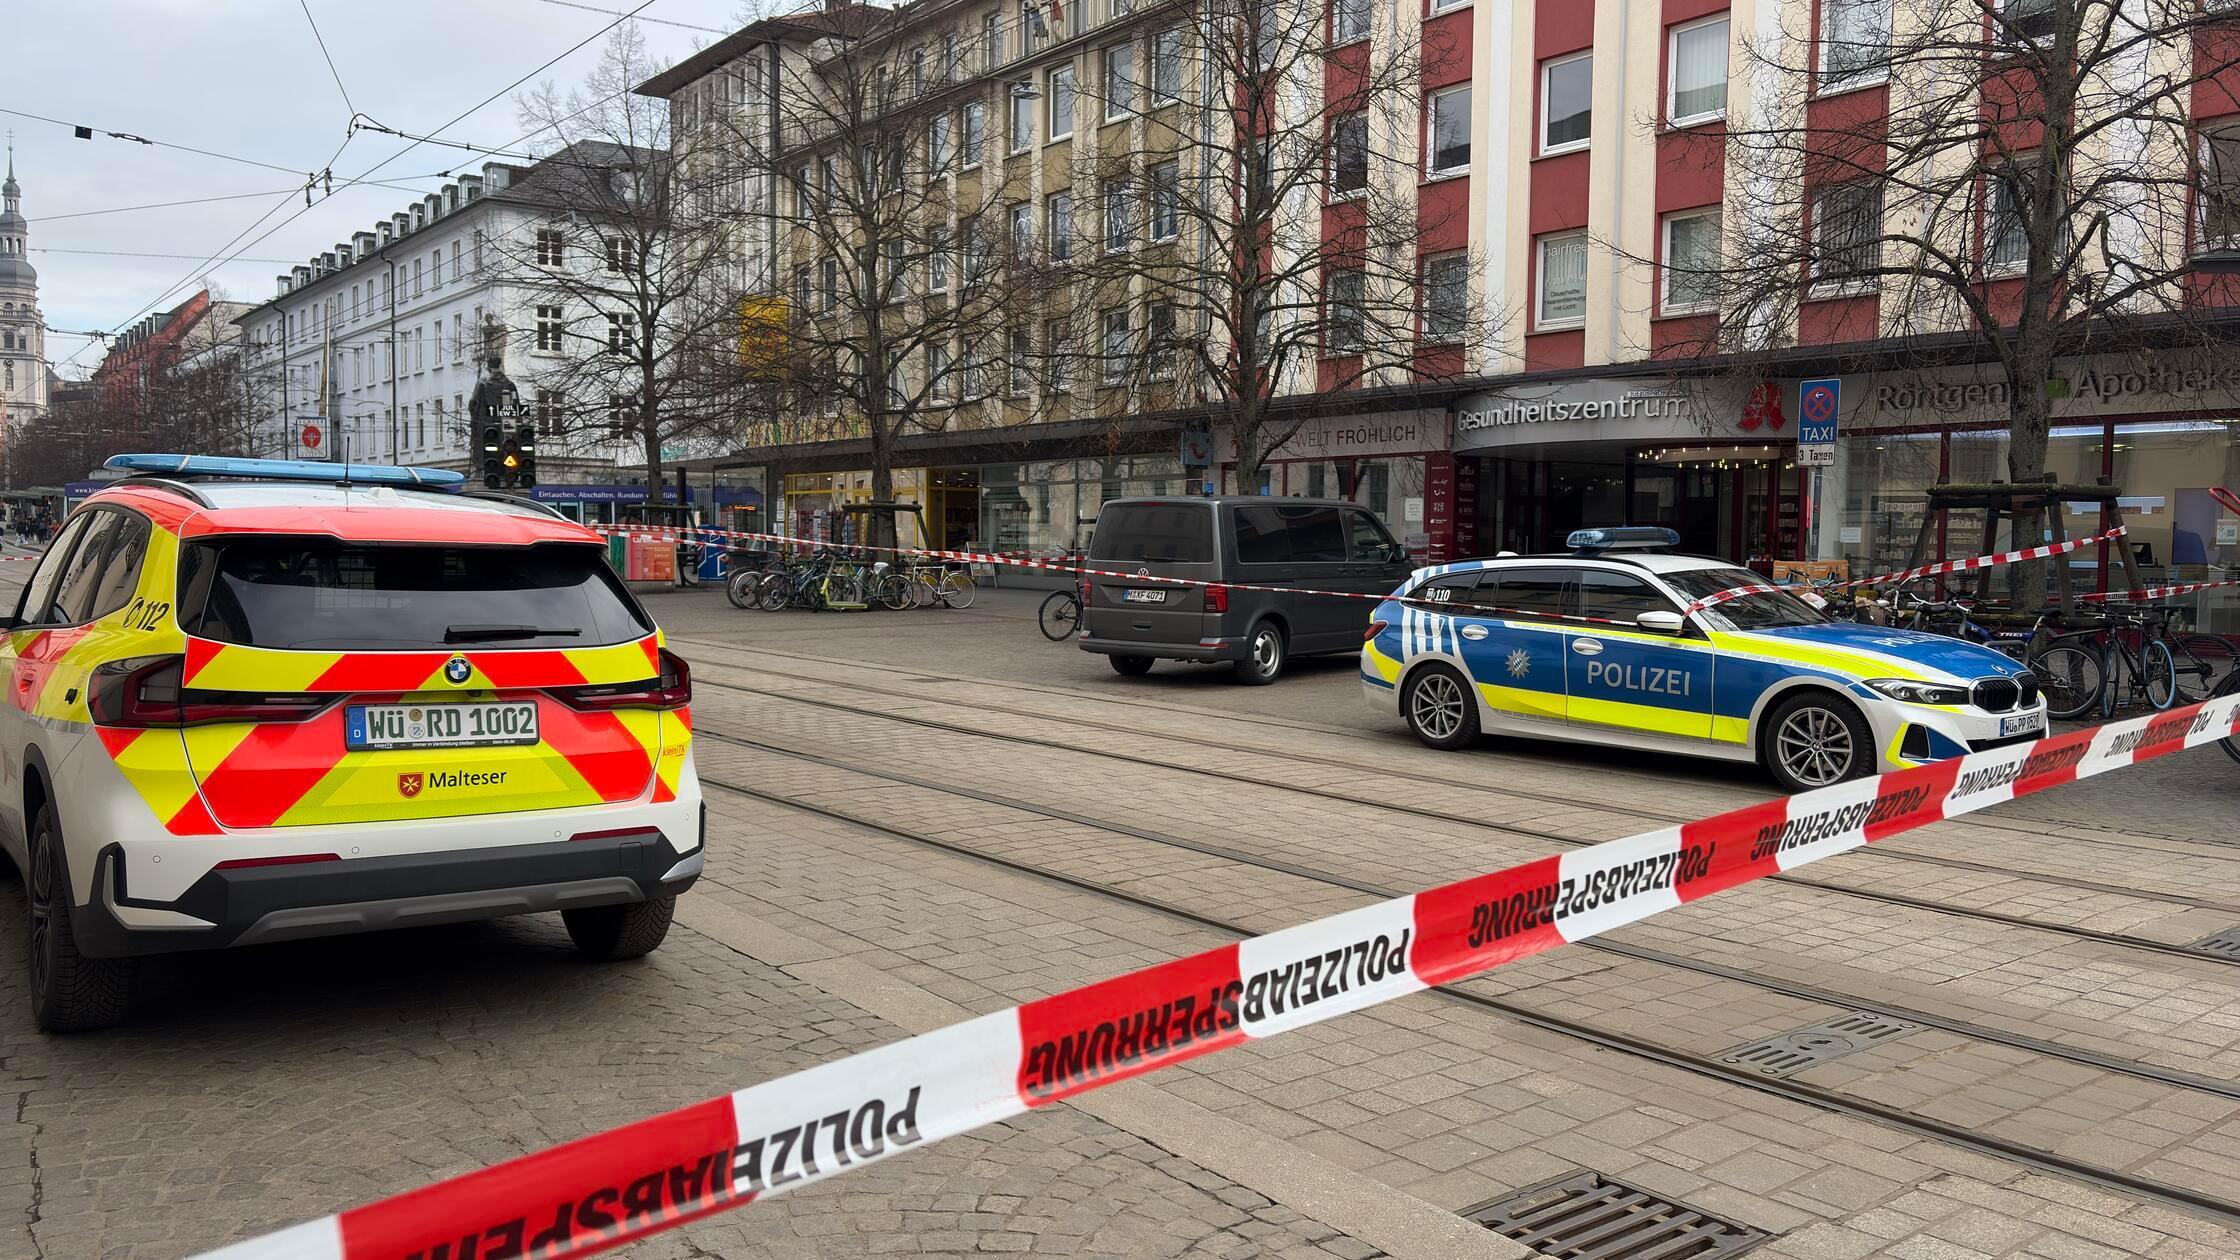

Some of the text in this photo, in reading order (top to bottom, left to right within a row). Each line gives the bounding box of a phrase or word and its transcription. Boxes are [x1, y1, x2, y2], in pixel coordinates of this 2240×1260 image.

[1458, 395, 1691, 431] Gesundheitszentrum
[1336, 425, 1416, 445] FRÖHLICH
[1799, 450, 1804, 461] 3
[578, 491, 615, 499] Abschalten.
[617, 491, 643, 499] Rundum
[1147, 591, 1164, 600] 4071
[1434, 589, 1451, 602] 110
[136, 601, 170, 631] 112
[1587, 660, 1691, 696] POLIZEI
[353, 729, 361, 738] D
[426, 708, 461, 738] RD
[469, 707, 534, 736] 1002
[429, 770, 507, 788] Malteser
[1750, 783, 1931, 860] POLIZEIABSPERRUNG
[1467, 841, 1716, 949] POLIZEIABSPERRUNG
[1025, 927, 1410, 1098] POLIZEIABSPERRUNG
